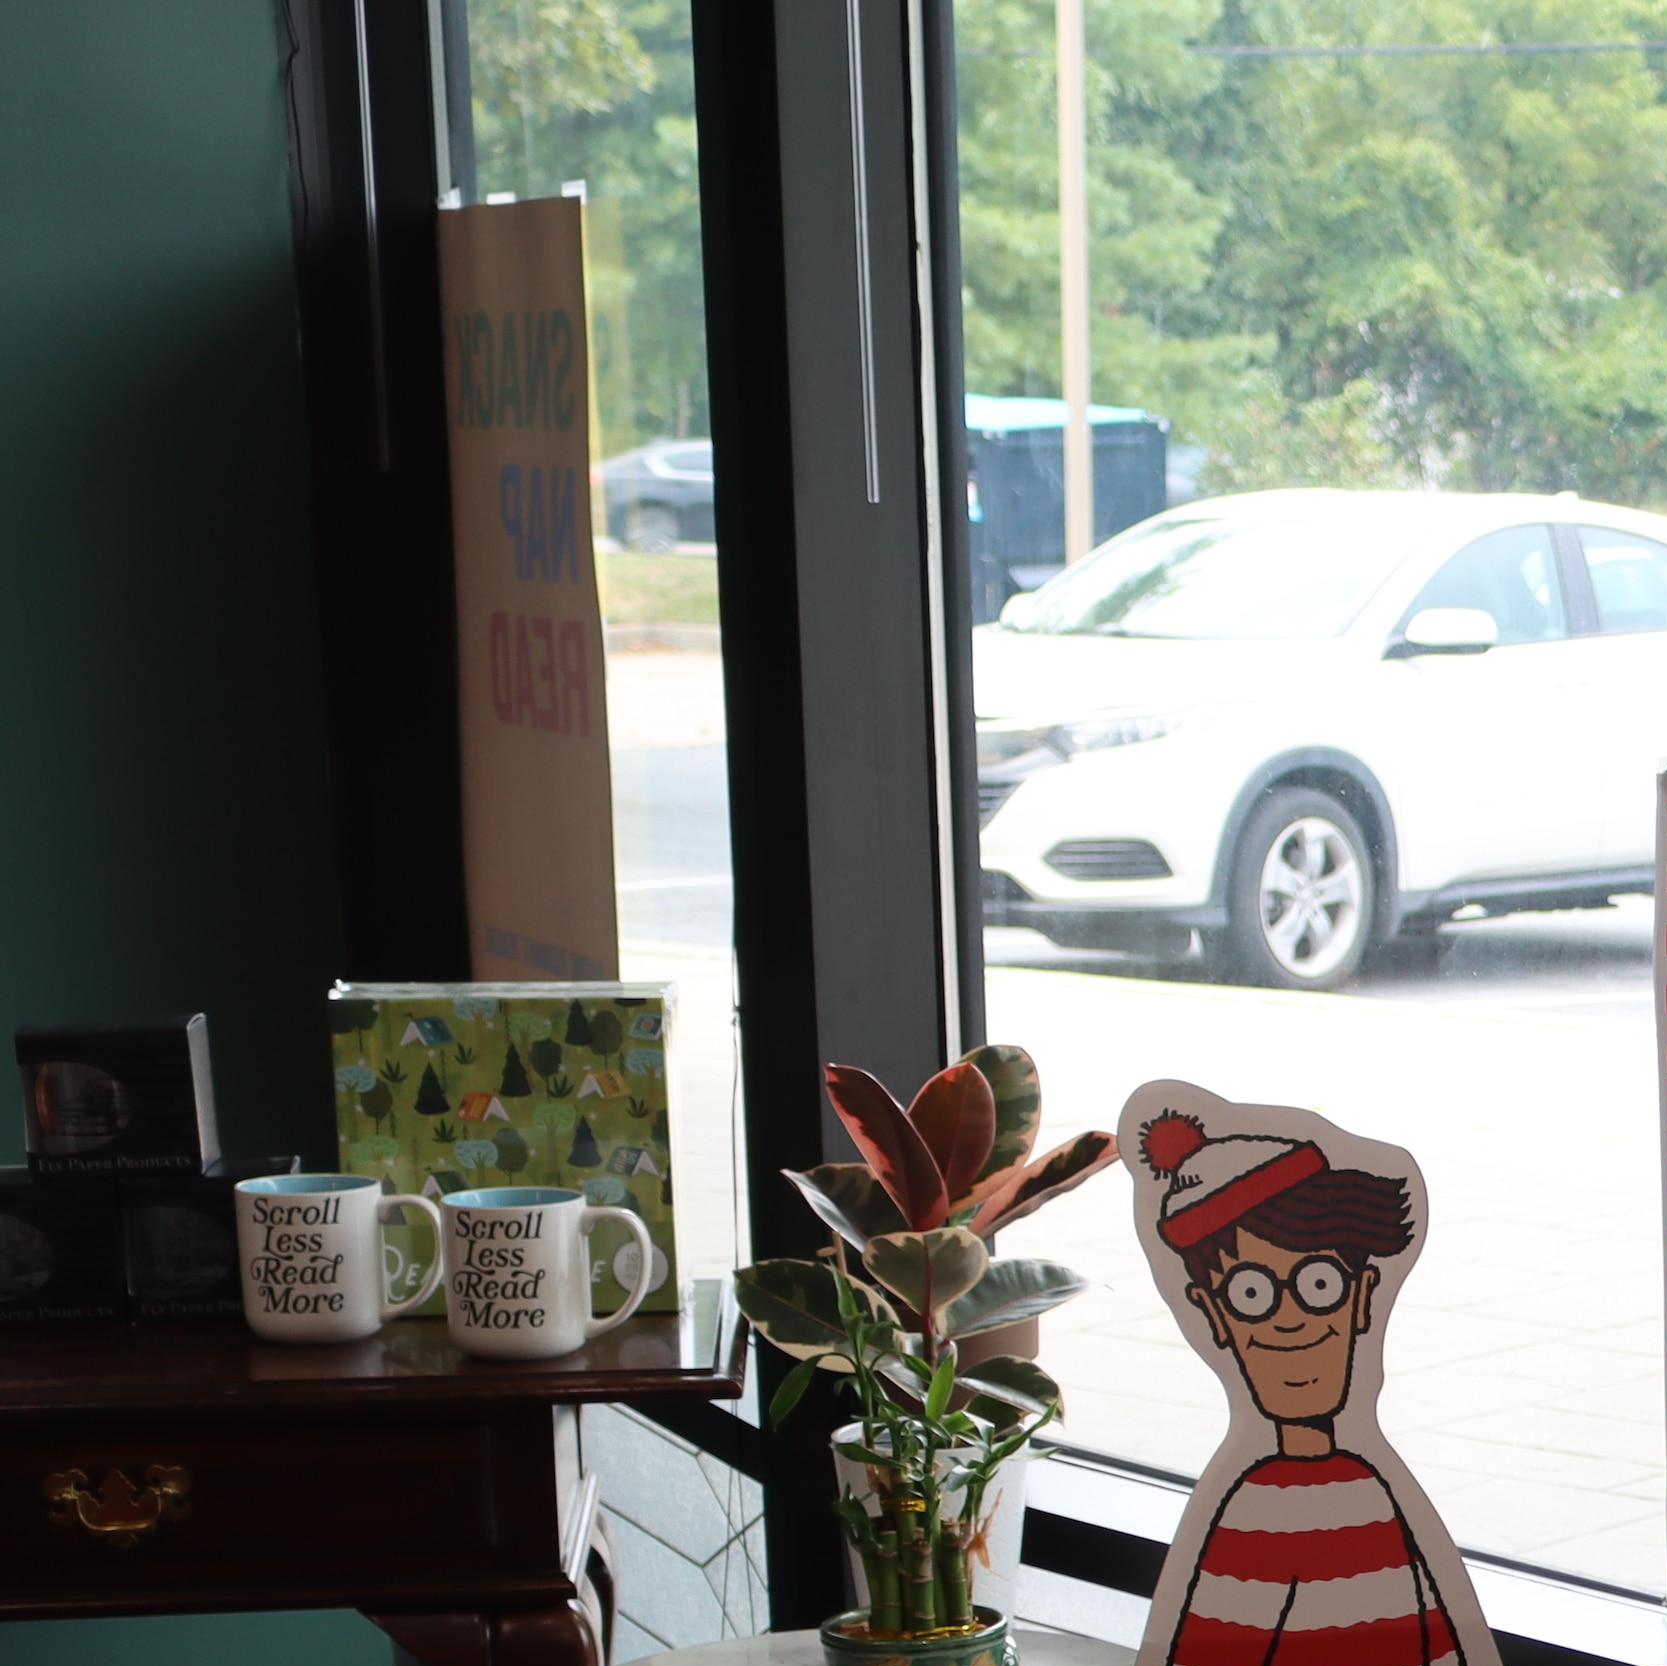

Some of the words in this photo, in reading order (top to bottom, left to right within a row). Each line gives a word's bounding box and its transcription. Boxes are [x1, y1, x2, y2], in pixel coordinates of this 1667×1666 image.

[252, 1196, 341, 1226] Scroll
[454, 1210, 543, 1240] Scroll
[263, 1225, 323, 1263] Less
[464, 1239, 525, 1277] Less
[250, 1254, 344, 1287] Read
[453, 1269, 545, 1301] Read
[258, 1287, 344, 1314] More
[459, 1301, 545, 1330] More
